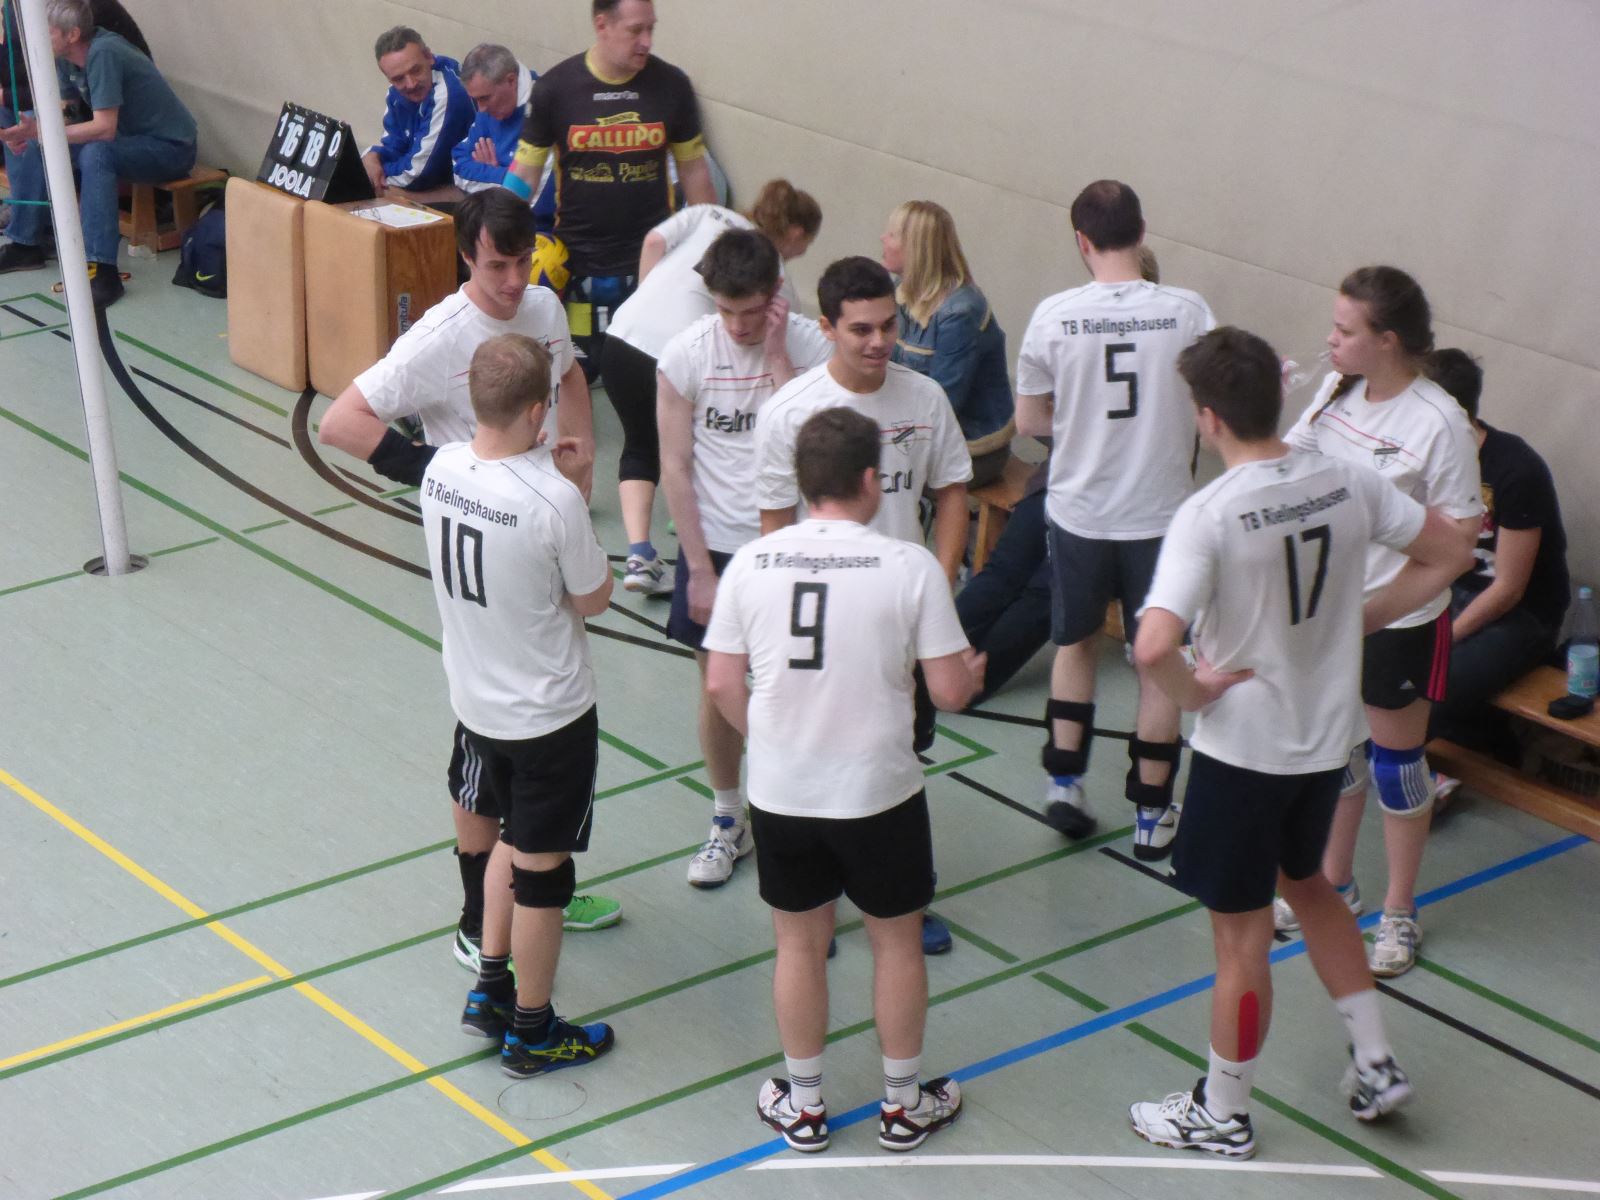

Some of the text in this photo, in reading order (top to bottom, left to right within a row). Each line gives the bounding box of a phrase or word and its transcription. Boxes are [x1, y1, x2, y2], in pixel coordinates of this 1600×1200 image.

[278, 112, 341, 167] 1 16 18 0
[571, 125, 664, 149] CALLIPO
[268, 163, 312, 198] JOOLA
[1061, 317, 1177, 336] TB Rielingshausen
[1105, 342, 1138, 419] 5
[425, 477, 518, 527] TB Rielingshausen
[1238, 486, 1351, 532] TB Rielingshausen
[441, 515, 487, 608] 10
[754, 552, 881, 574] TB Rielingshausen
[1284, 523, 1331, 625] 17
[788, 581, 828, 670] 9
